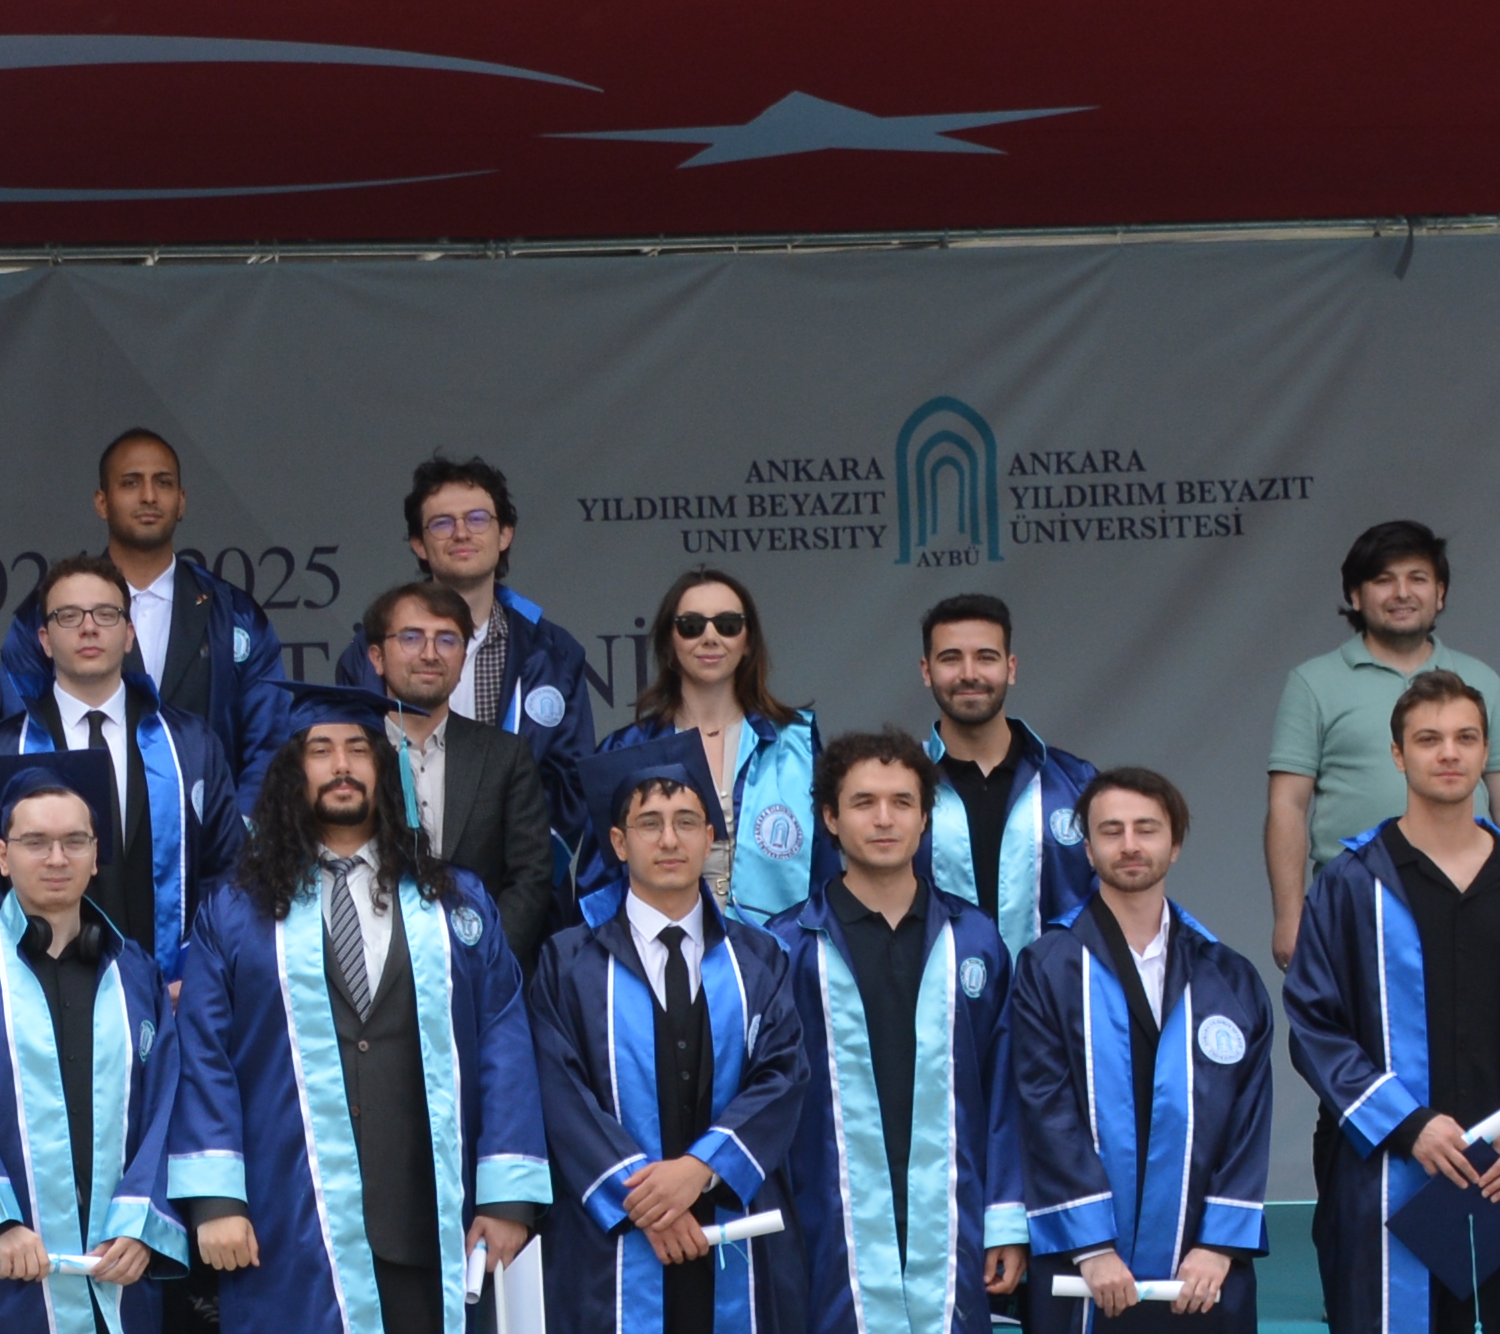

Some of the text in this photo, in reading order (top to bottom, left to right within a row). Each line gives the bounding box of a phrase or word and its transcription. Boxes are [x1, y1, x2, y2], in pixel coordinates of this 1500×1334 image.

[745, 457, 885, 484] ANKARA
[1008, 449, 1146, 477] ANKARA
[577, 490, 886, 523] YILDIRIM BEYAZIT
[1009, 475, 1314, 510] YILDIRIM BEYAZIT
[681, 524, 888, 554] UNIVERSITY
[1010, 505, 1245, 544] ÜNİVERSİTESİ
[916, 544, 981, 569] AYBÜ
